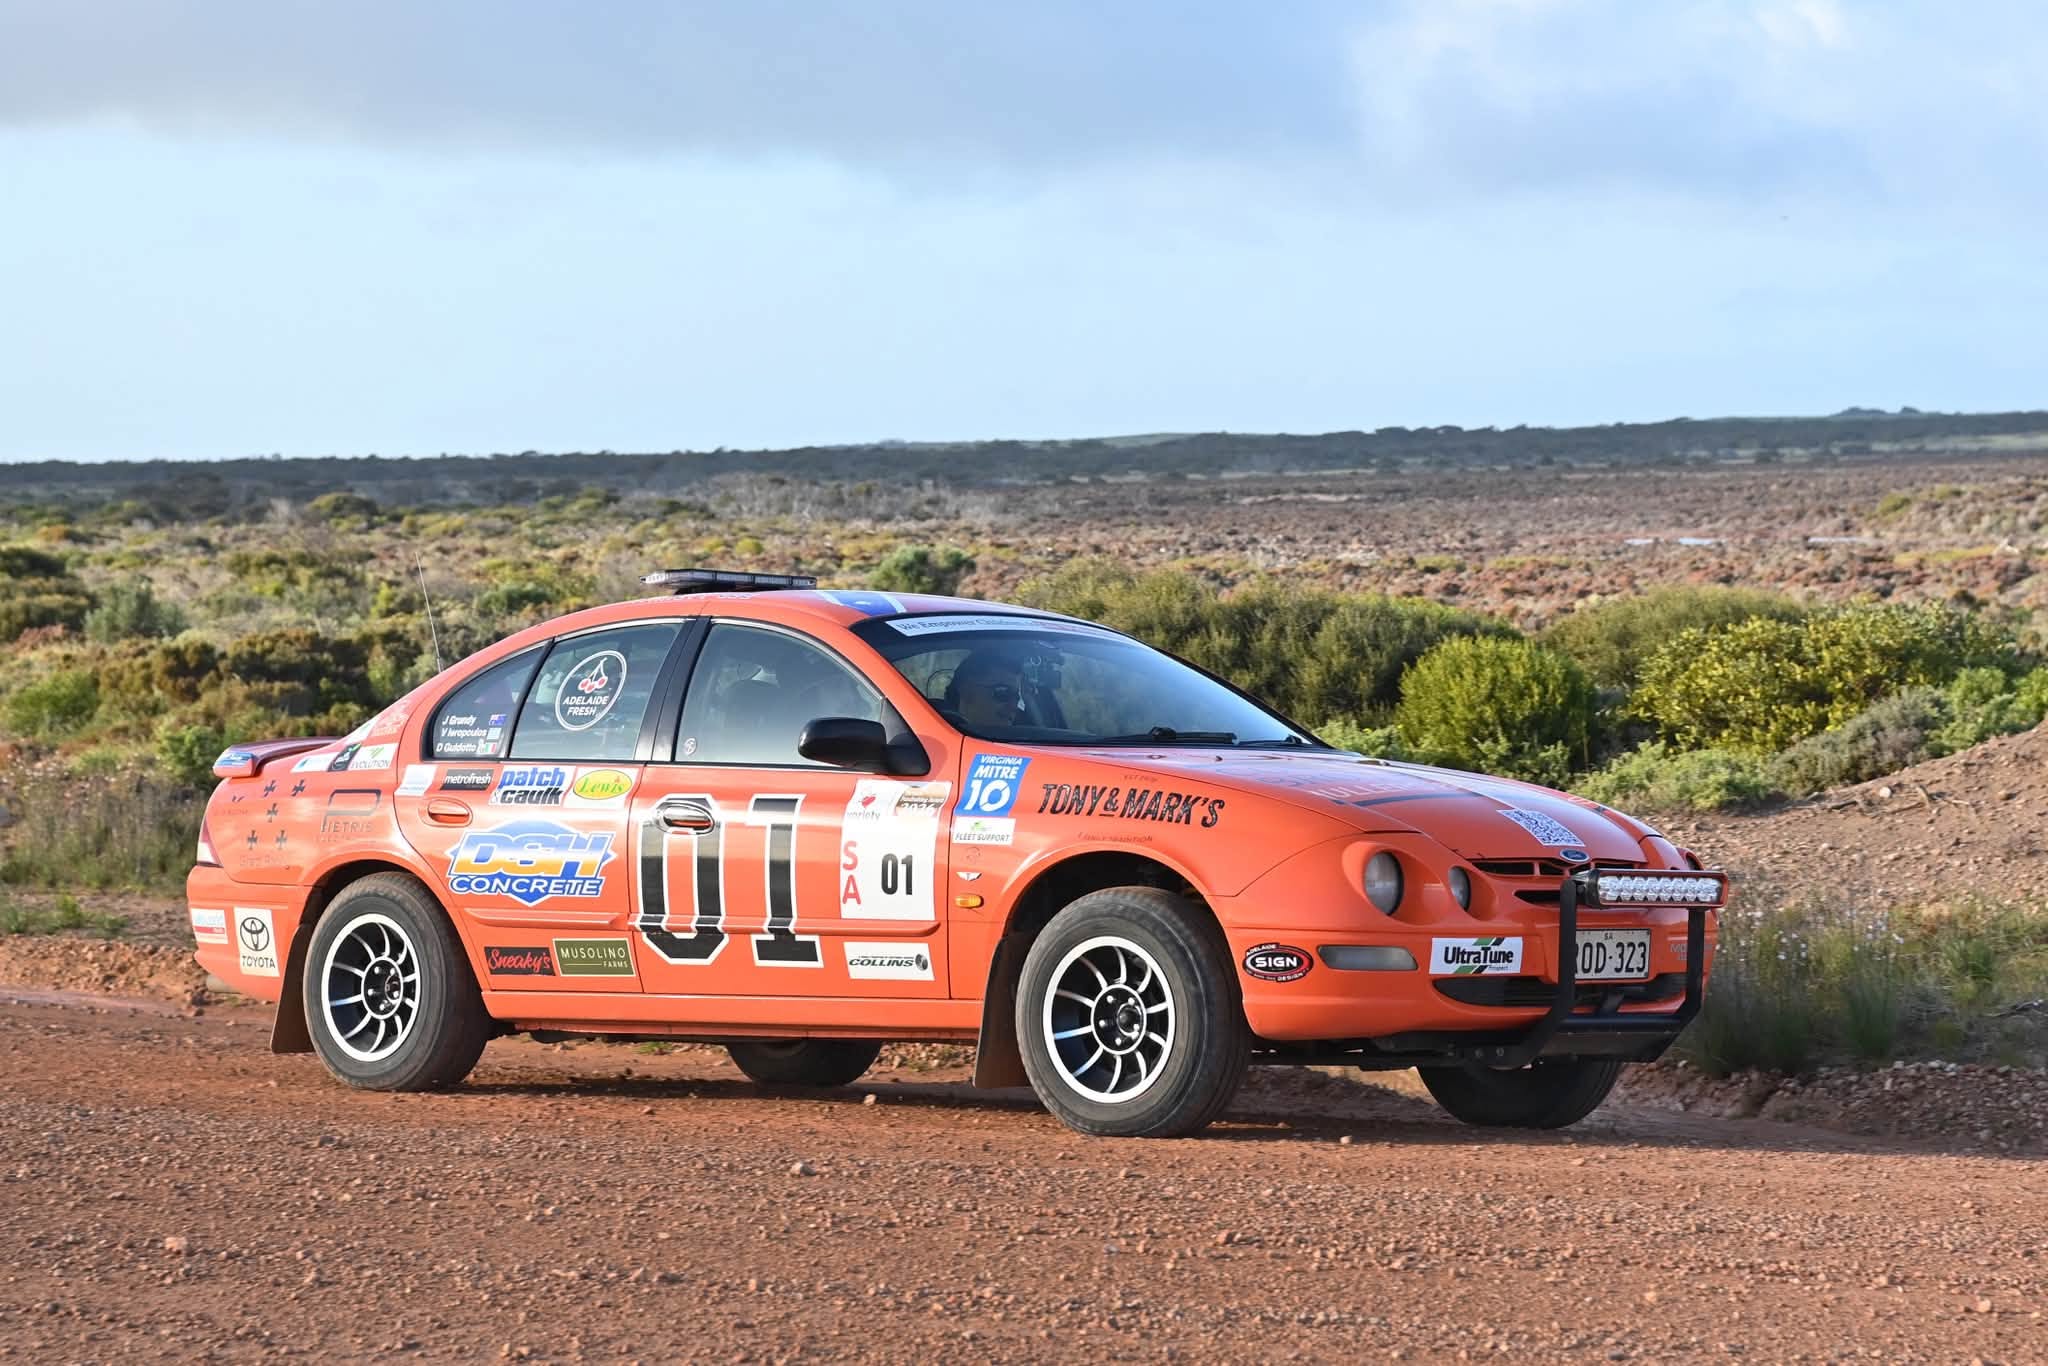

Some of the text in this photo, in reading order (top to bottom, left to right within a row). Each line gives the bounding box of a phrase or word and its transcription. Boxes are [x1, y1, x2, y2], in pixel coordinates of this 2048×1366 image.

[563, 695, 609, 705] ADELAIDE
[567, 706, 597, 716] FRESH
[442, 715, 449, 726] J
[436, 743, 444, 752] D
[981, 755, 1023, 765] VIRGINIA
[444, 772, 491, 784] metrofresh
[497, 767, 566, 789] patch
[973, 764, 1019, 779] MITRE
[579, 776, 624, 793] Lewis
[500, 787, 564, 804] caulk
[963, 779, 1011, 812] 10
[955, 832, 1010, 842] FLEET SUPPORT
[637, 793, 824, 968] 01
[881, 853, 913, 895] 01
[451, 877, 602, 895] CONCRETE
[560, 947, 626, 959] MUSOLINO
[1246, 944, 1276, 957] ADELAIDE
[241, 955, 276, 969] TOYOTA
[488, 948, 552, 973] Sneaky's
[849, 958, 914, 967] COLLINS
[1255, 956, 1298, 968] SIGN
